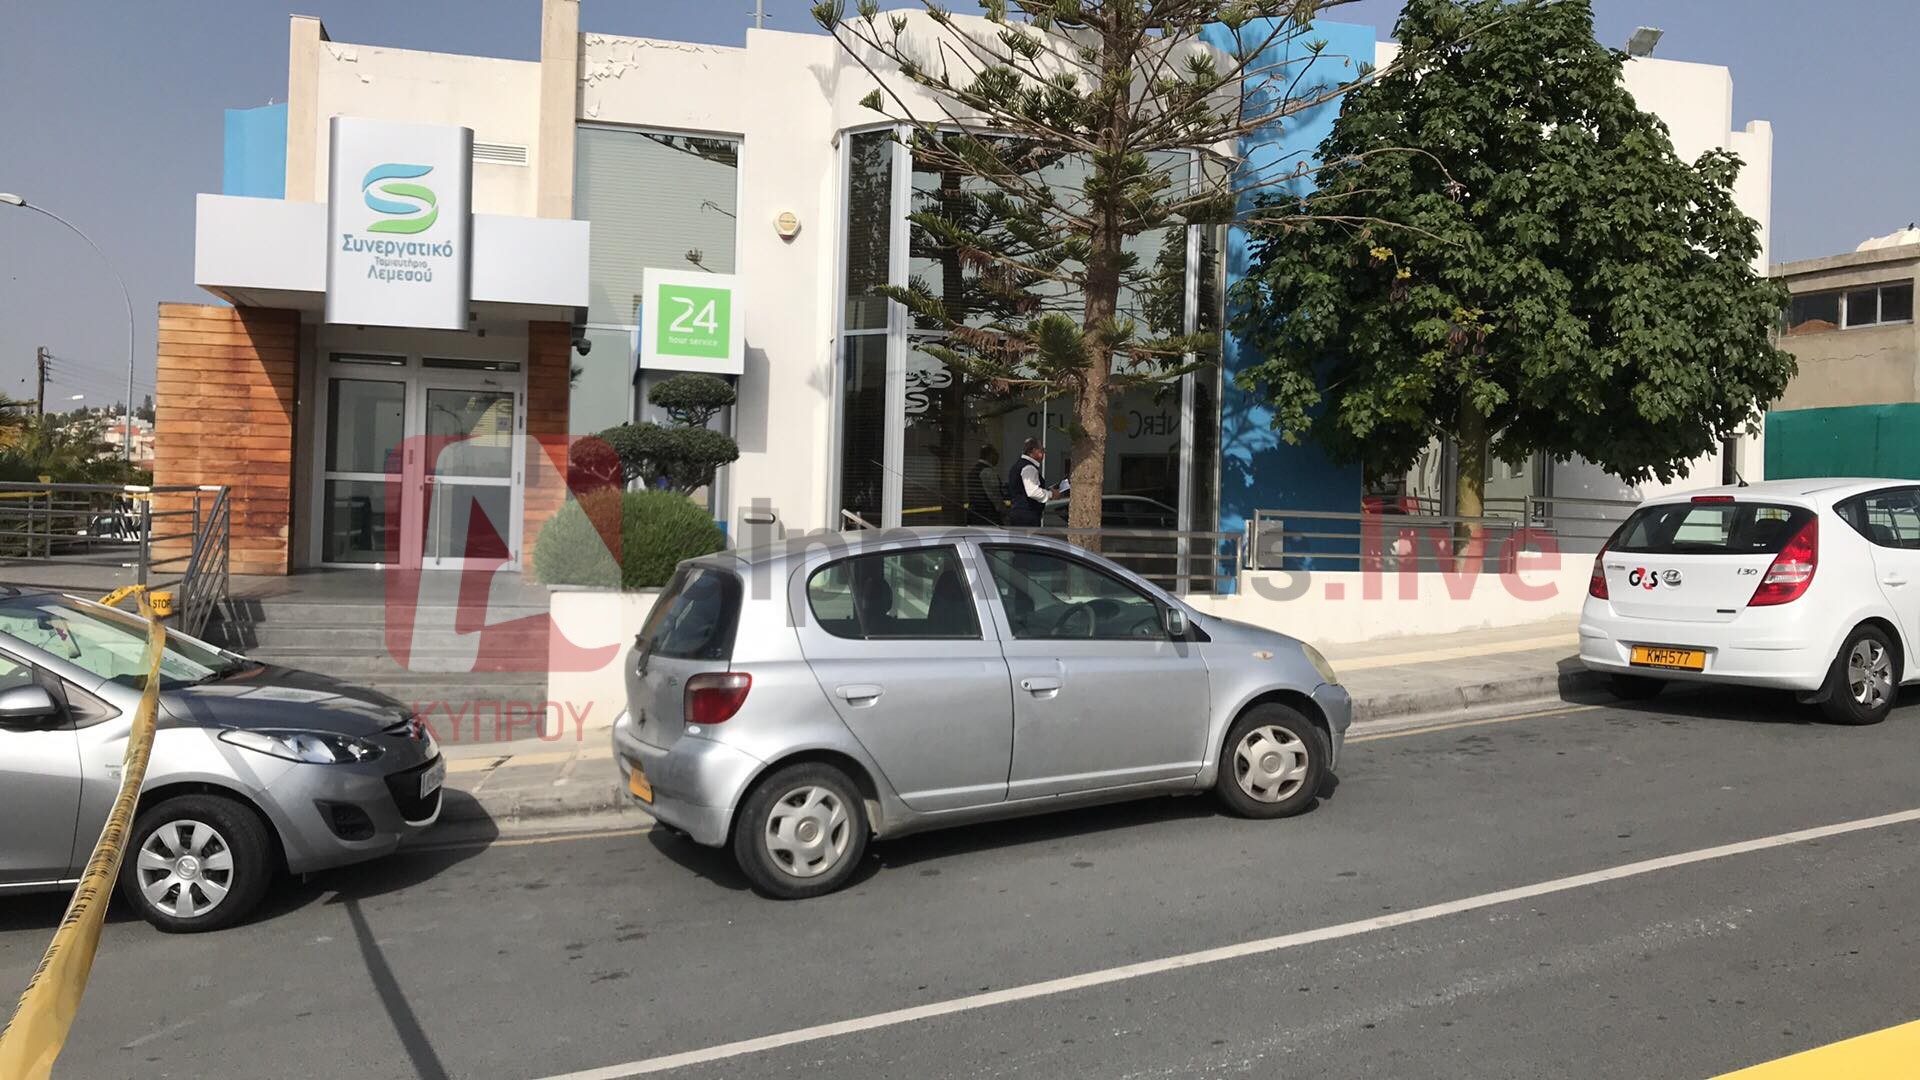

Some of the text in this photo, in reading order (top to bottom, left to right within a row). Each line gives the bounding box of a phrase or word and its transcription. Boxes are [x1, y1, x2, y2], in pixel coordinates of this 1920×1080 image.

[342, 234, 453, 258] Συνεργατικό
[367, 265, 433, 283] Λεμεσού
[668, 296, 719, 335] 24
[668, 335, 718, 347] hour service
[1629, 567, 1659, 591] G4S
